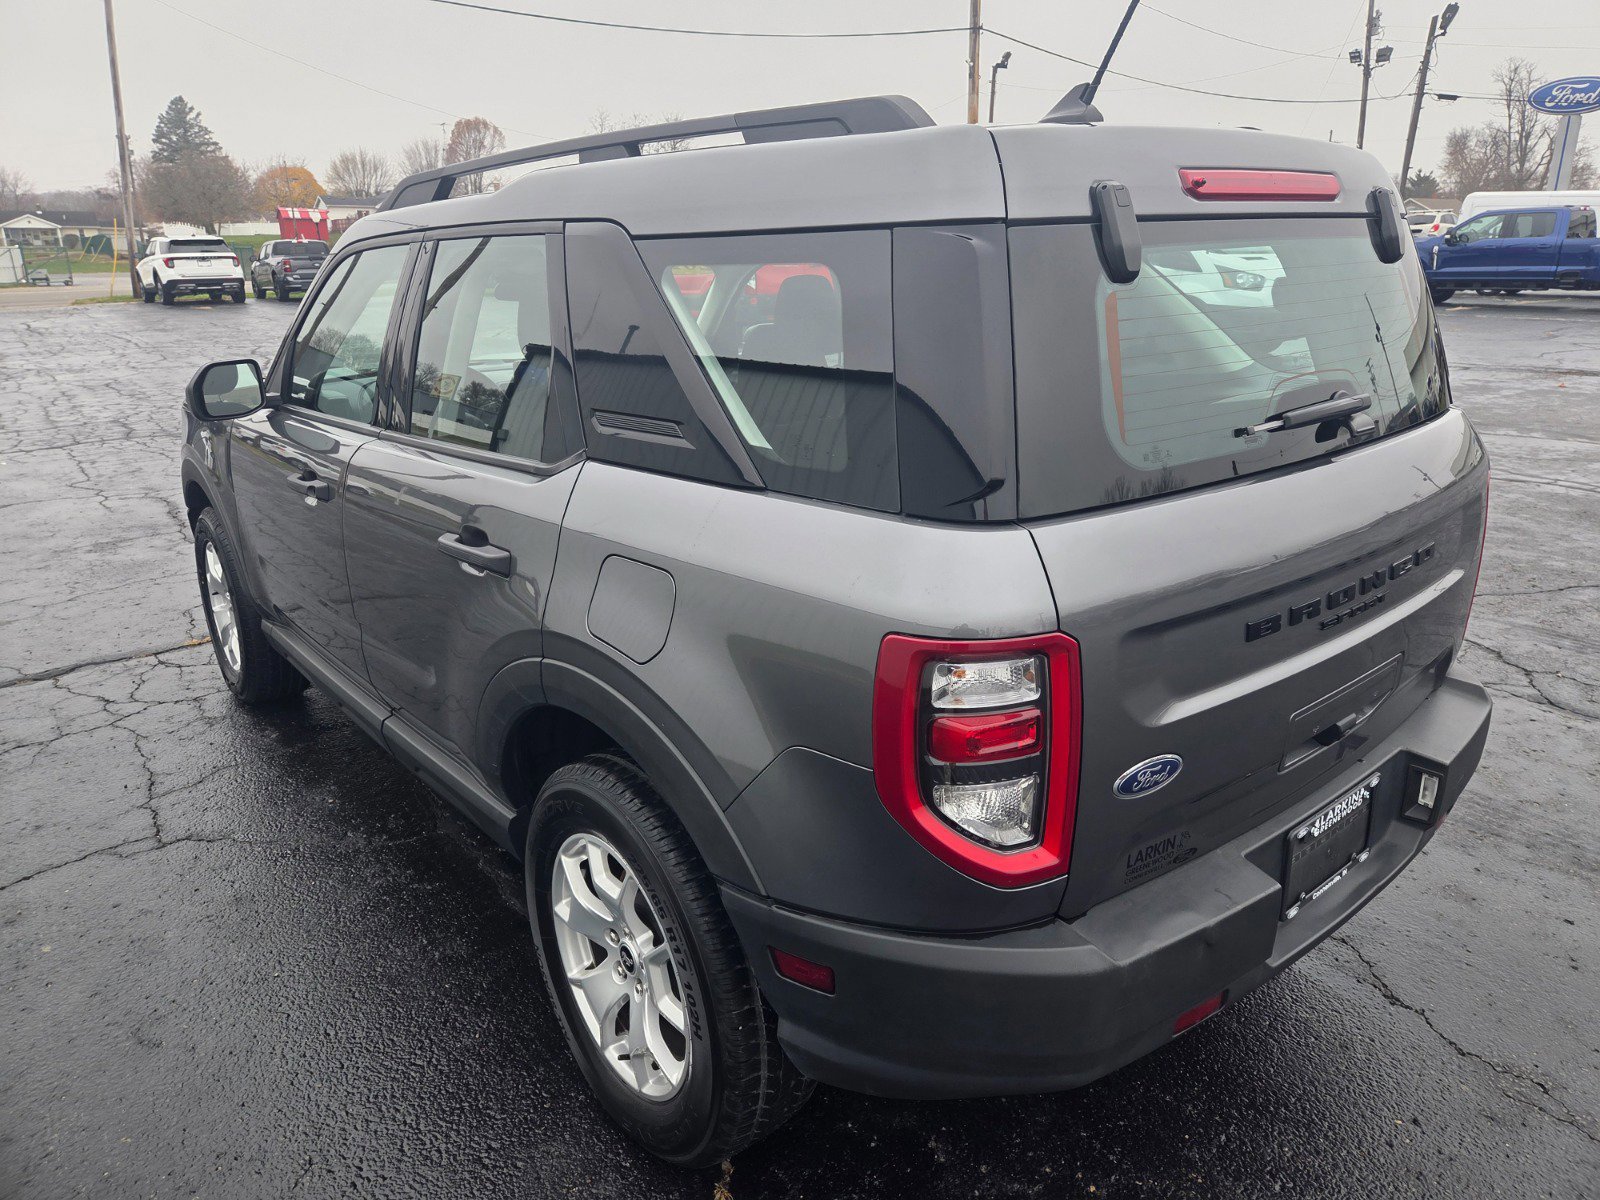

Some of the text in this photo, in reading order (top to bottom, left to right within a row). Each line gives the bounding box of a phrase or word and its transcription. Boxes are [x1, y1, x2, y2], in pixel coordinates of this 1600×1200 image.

[1545, 83, 1600, 107] Ford
[1245, 541, 1435, 642] BRONCO
[1319, 589, 1390, 631] SPORT
[1133, 764, 1171, 792] Ford
[1319, 790, 1361, 826] LARKIN
[1126, 834, 1176, 869] LARKIN
[629, 853, 668, 920] 225/65
[665, 926, 688, 973] R17
[683, 979, 703, 1042] 102H
